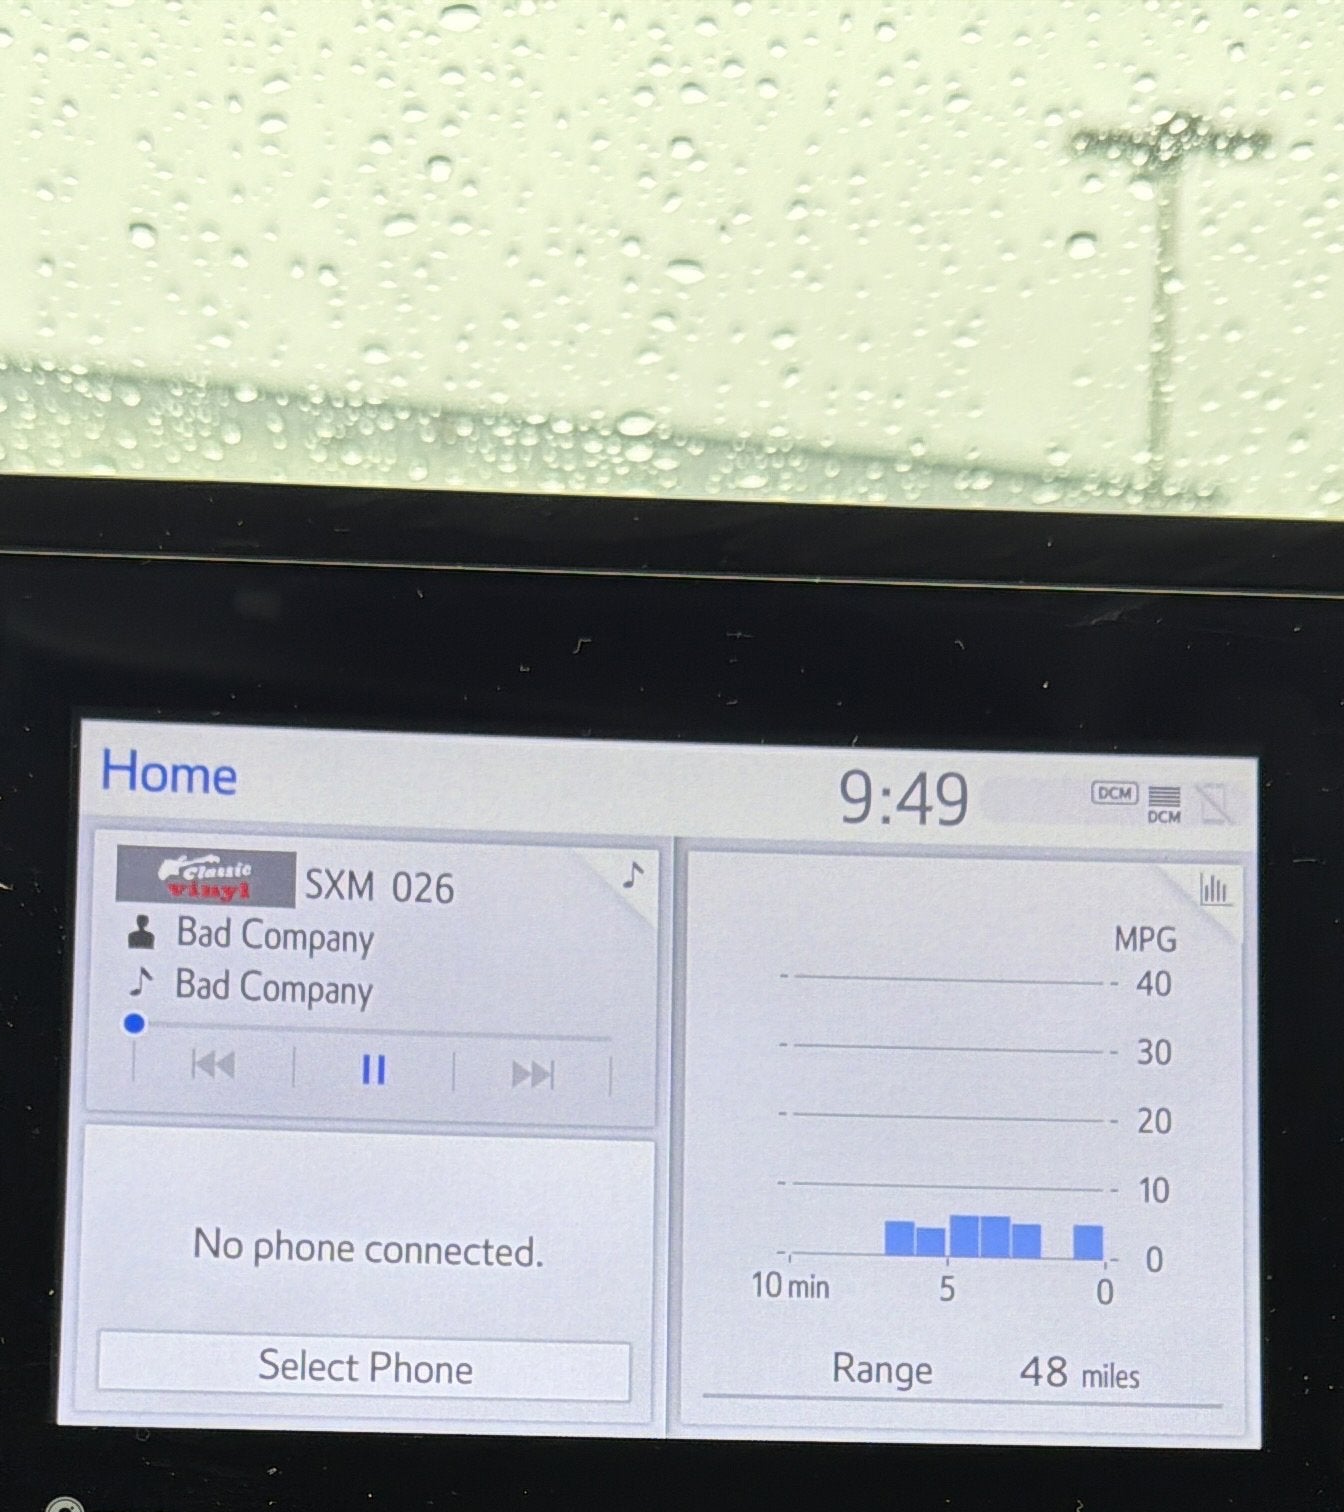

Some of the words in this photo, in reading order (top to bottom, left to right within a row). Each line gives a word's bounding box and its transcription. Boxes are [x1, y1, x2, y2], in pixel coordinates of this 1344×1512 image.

[101, 747, 238, 796] Home
[838, 767, 971, 827] 9:49
[1098, 785, 1133, 802] DCM
[1146, 810, 1182, 825] DCM
[182, 860, 253, 881] Classic
[305, 866, 376, 903] SXM
[391, 870, 456, 904] 026
[167, 880, 251, 903] vinyl
[177, 915, 232, 949] Bad
[241, 917, 376, 961] Company
[1114, 924, 1178, 954] MPG
[175, 967, 230, 1001] Bad
[239, 969, 375, 1012] Company
[1135, 969, 1173, 998] 40
[1136, 1037, 1173, 1066] 30
[1136, 1106, 1173, 1135] 20
[1138, 1176, 1171, 1204] 10
[192, 1226, 244, 1261] No
[253, 1228, 356, 1268] phone
[363, 1234, 545, 1269] connected.
[1144, 1244, 1164, 1275] 0
[750, 1269, 784, 1299] 10
[788, 1274, 831, 1301] min
[938, 1274, 957, 1304] 5
[1095, 1277, 1116, 1307] 0
[258, 1347, 360, 1382] Select
[369, 1351, 474, 1386] Phone
[833, 1352, 934, 1391] Range
[1019, 1355, 1069, 1389] 48
[1081, 1362, 1140, 1391] miles
